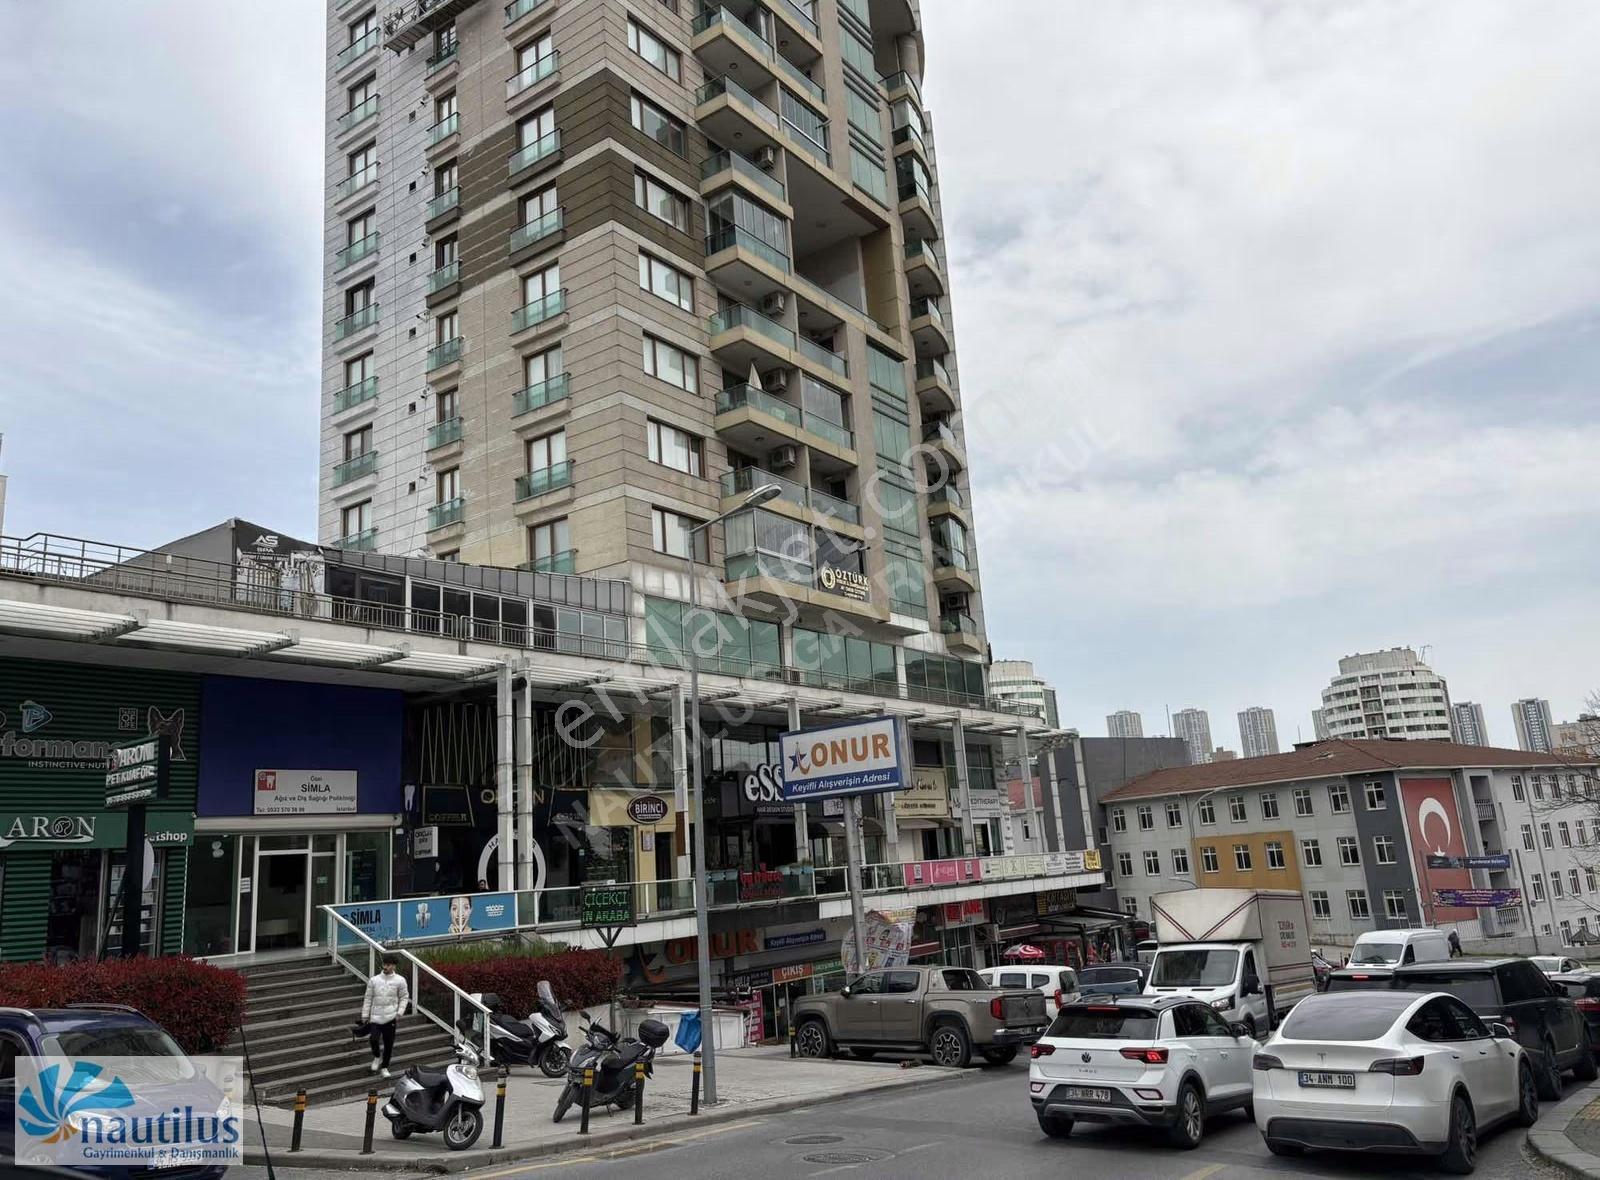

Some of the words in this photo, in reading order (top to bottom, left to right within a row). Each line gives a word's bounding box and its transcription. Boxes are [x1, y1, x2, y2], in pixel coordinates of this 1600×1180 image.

[835, 566, 869, 586] ÖZTÜRK
[811, 733, 891, 768] ONUR
[301, 783, 331, 793] SİMLA
[792, 781, 817, 793] Keyifli
[818, 775, 861, 790] Alışverişin
[862, 771, 890, 784] Adresi
[635, 801, 664, 814] BİRİNCİ
[7, 816, 96, 838] ARON
[145, 830, 188, 842] tshop
[350, 908, 381, 926] SİMLA
[781, 964, 804, 979] ÇIKIŞ
[1303, 1074, 1313, 1083] 34
[1338, 1075, 1352, 1084] 100
